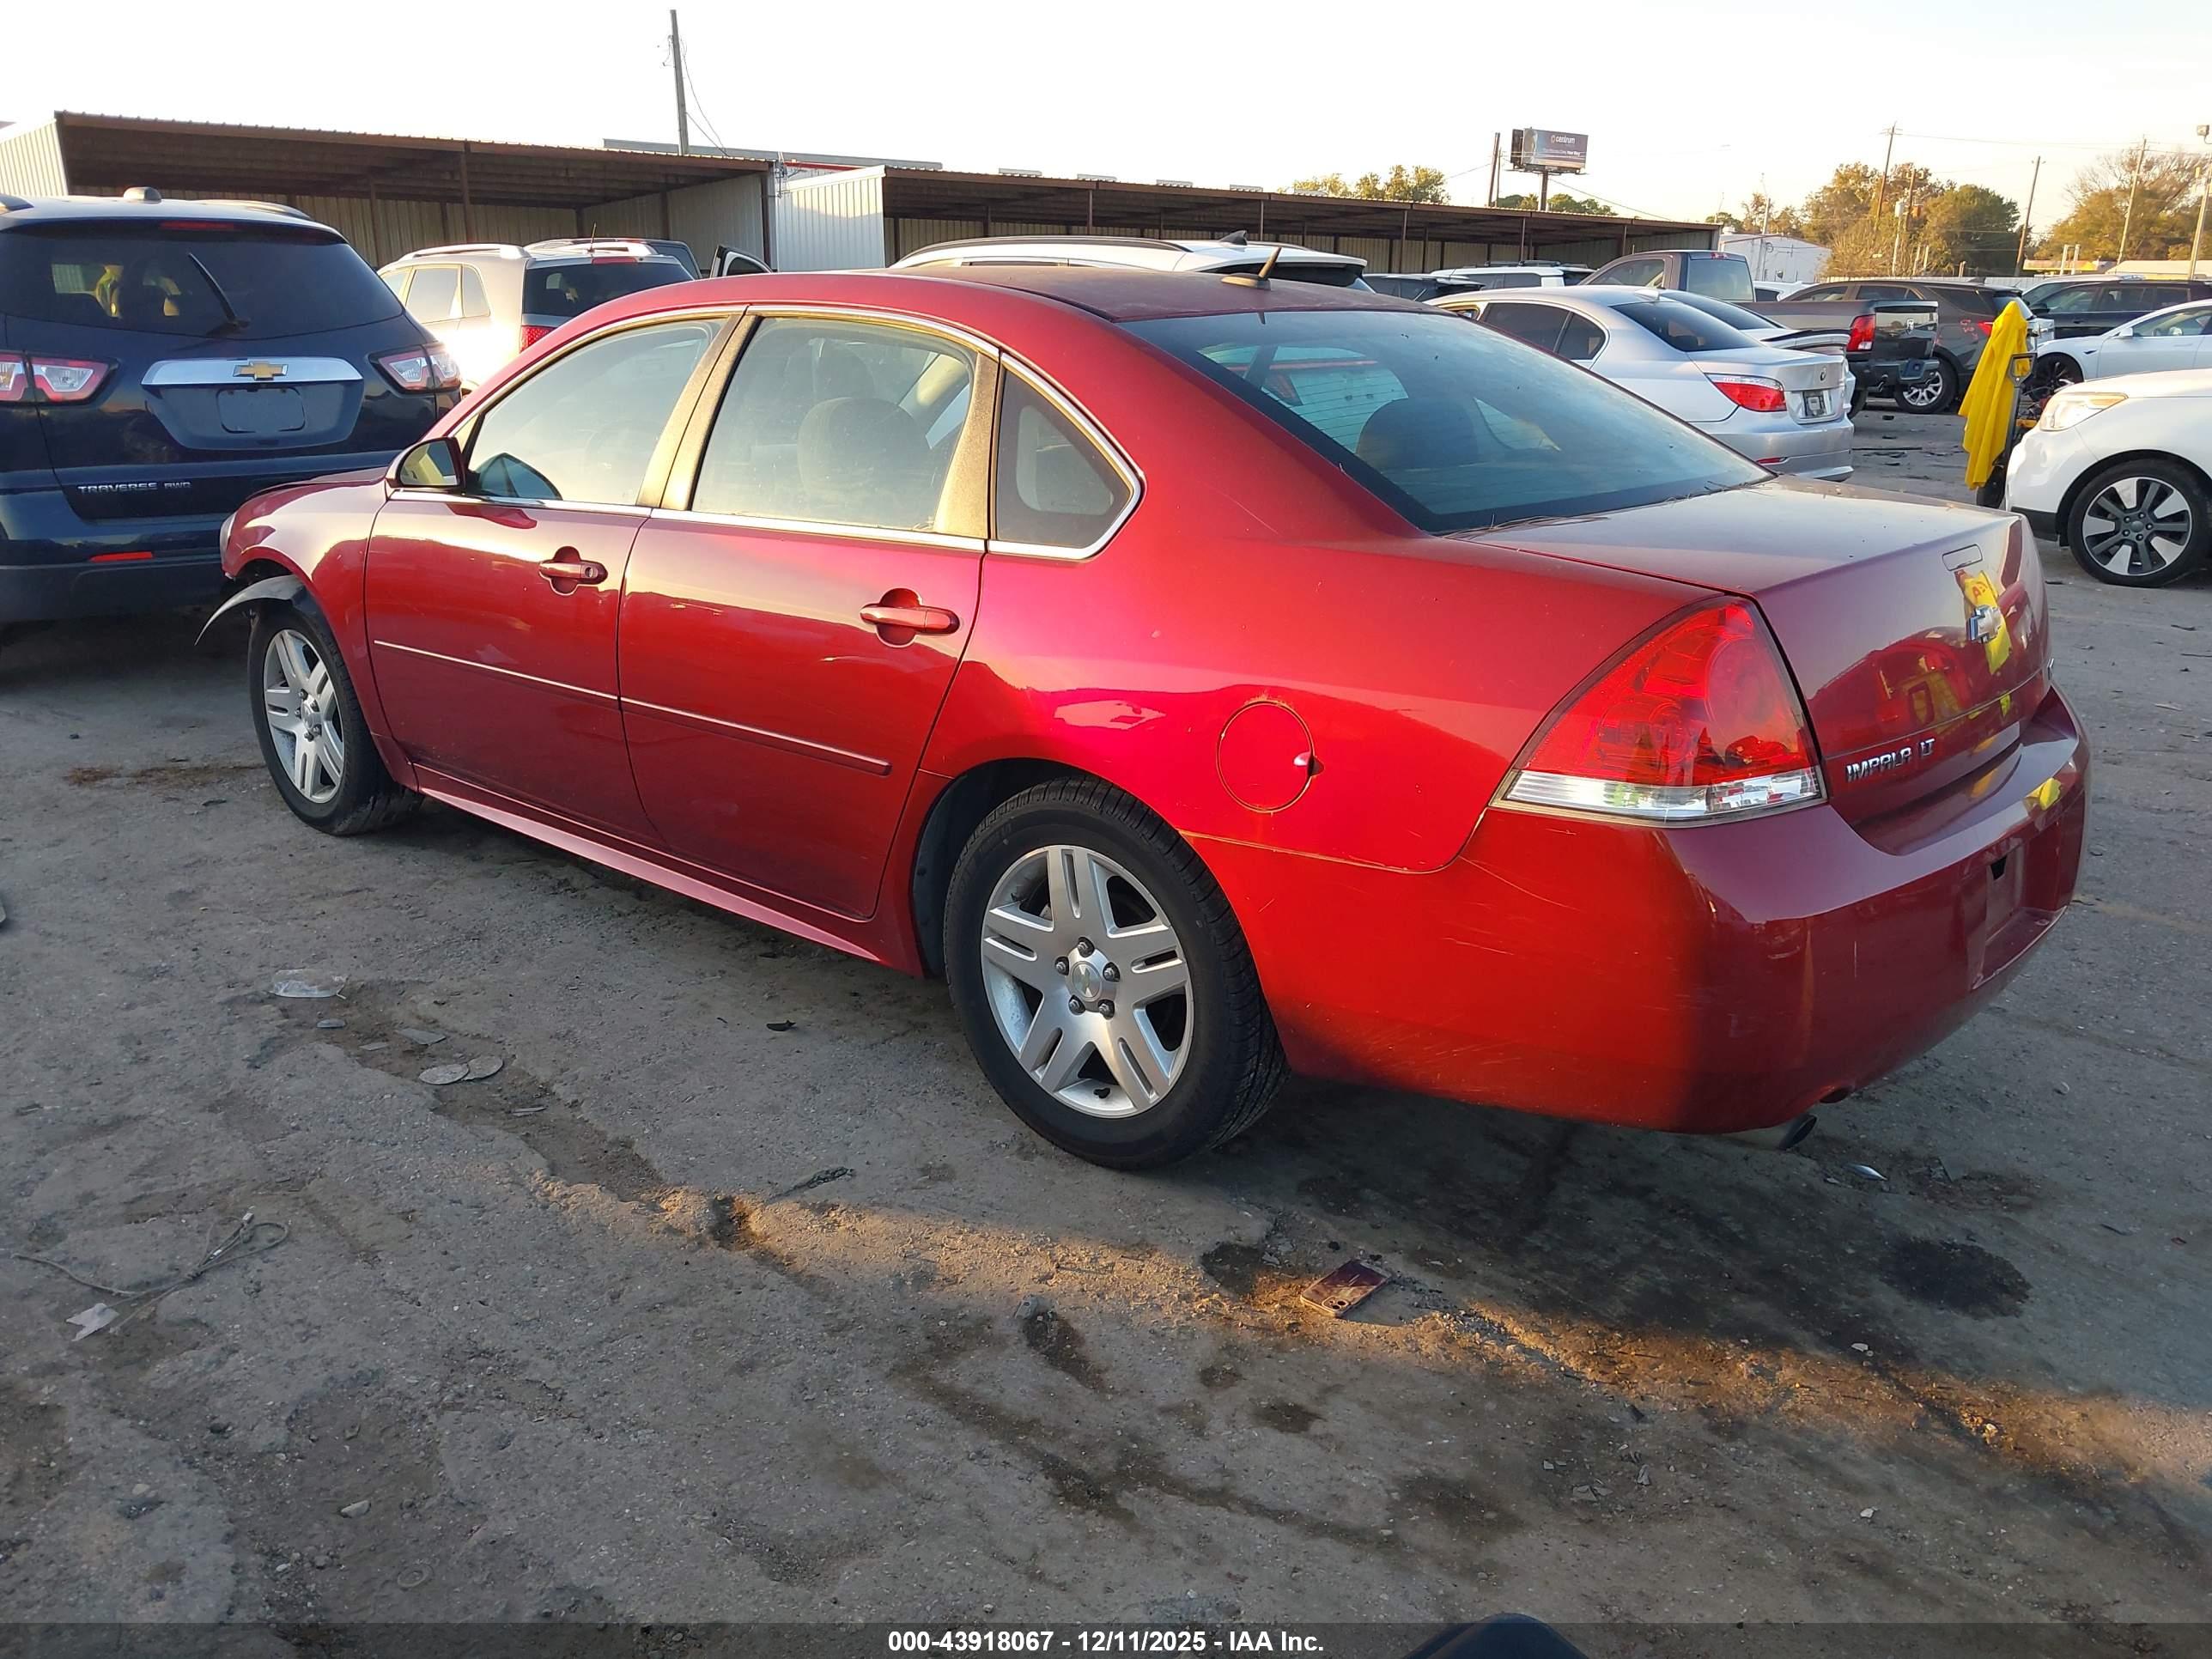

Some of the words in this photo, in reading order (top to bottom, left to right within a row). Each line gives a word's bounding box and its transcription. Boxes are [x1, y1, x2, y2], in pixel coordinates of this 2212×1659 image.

[77, 483, 157, 494] TRAVERSE
[1845, 747, 1912, 782] IMPALA
[1920, 738, 1936, 757] LT
